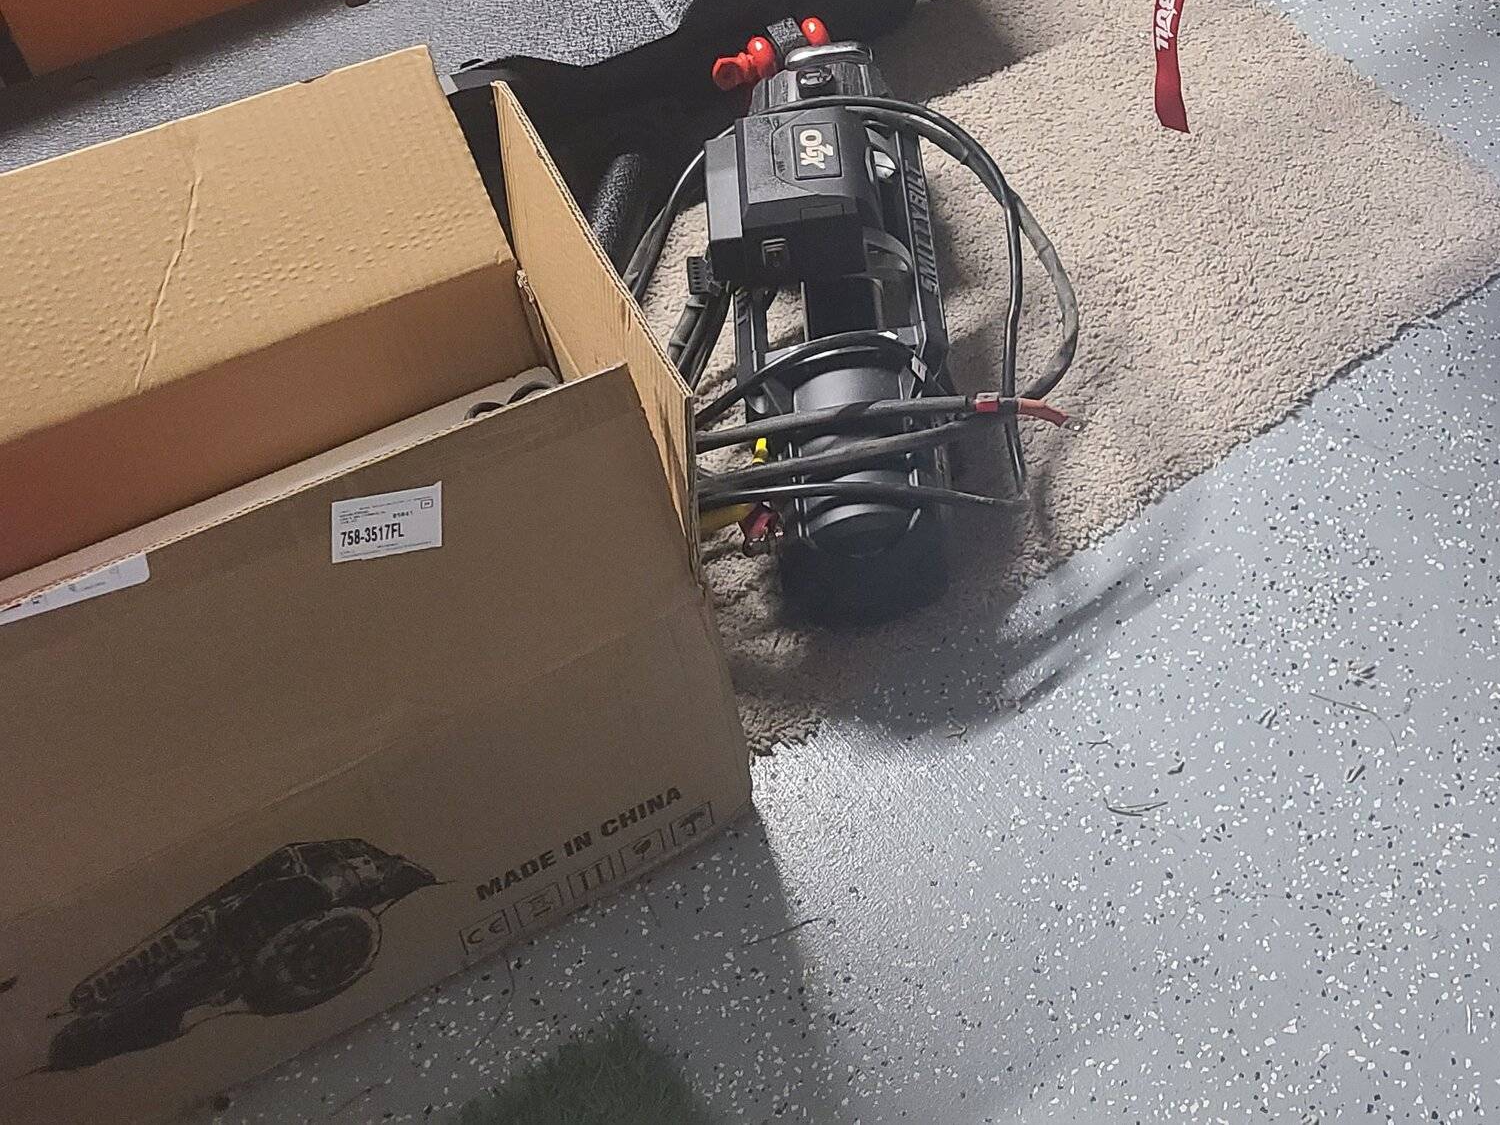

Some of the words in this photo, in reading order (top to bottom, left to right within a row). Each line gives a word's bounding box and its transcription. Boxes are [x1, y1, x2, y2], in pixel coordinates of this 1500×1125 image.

[904, 159, 939, 294] SMITTYBILT
[340, 523, 404, 548] 758-3517FL
[476, 850, 557, 901] MADE
[563, 831, 593, 857] IN
[600, 787, 681, 837] CHINA
